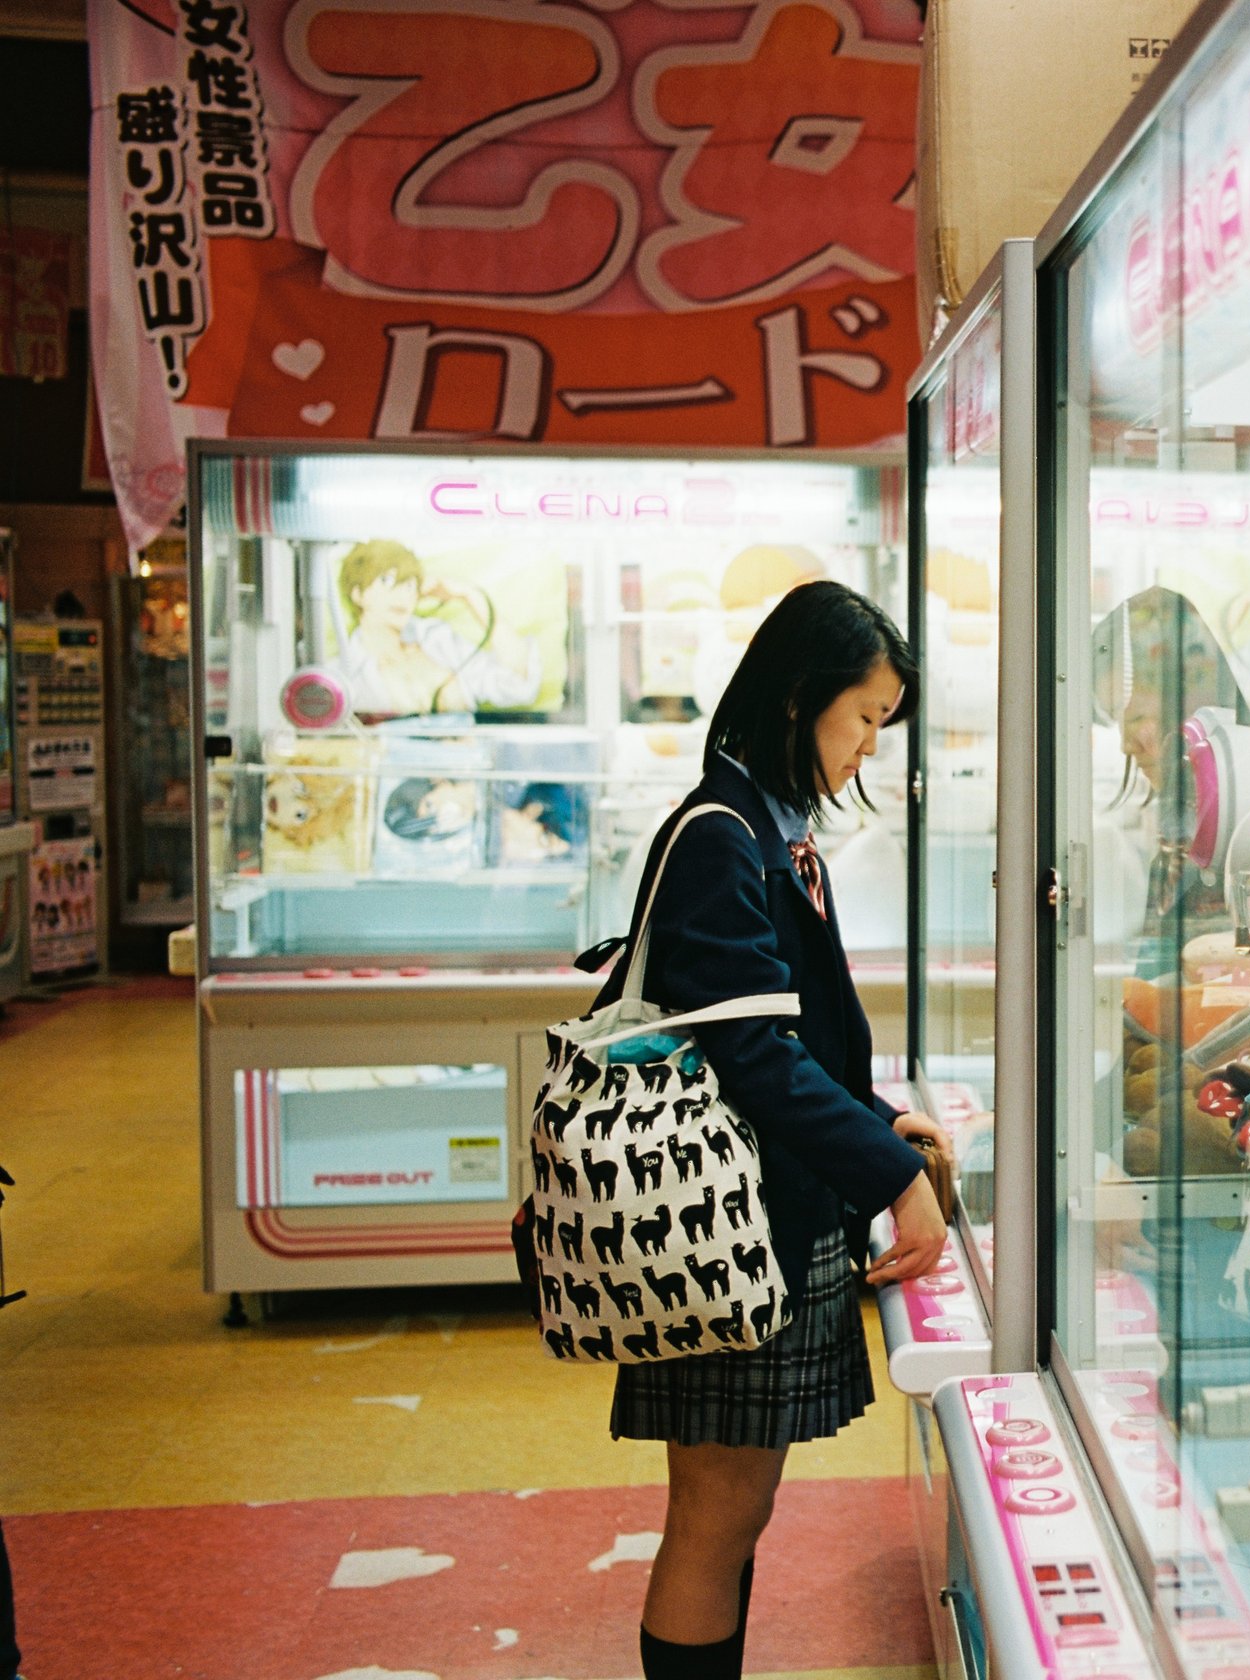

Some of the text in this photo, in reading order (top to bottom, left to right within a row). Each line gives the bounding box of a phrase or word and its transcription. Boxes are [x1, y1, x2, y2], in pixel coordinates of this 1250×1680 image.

[180, 0, 268, 229] 女性景品
[372, 297, 888, 446] ロード
[386, 1171, 433, 1185] OUT
